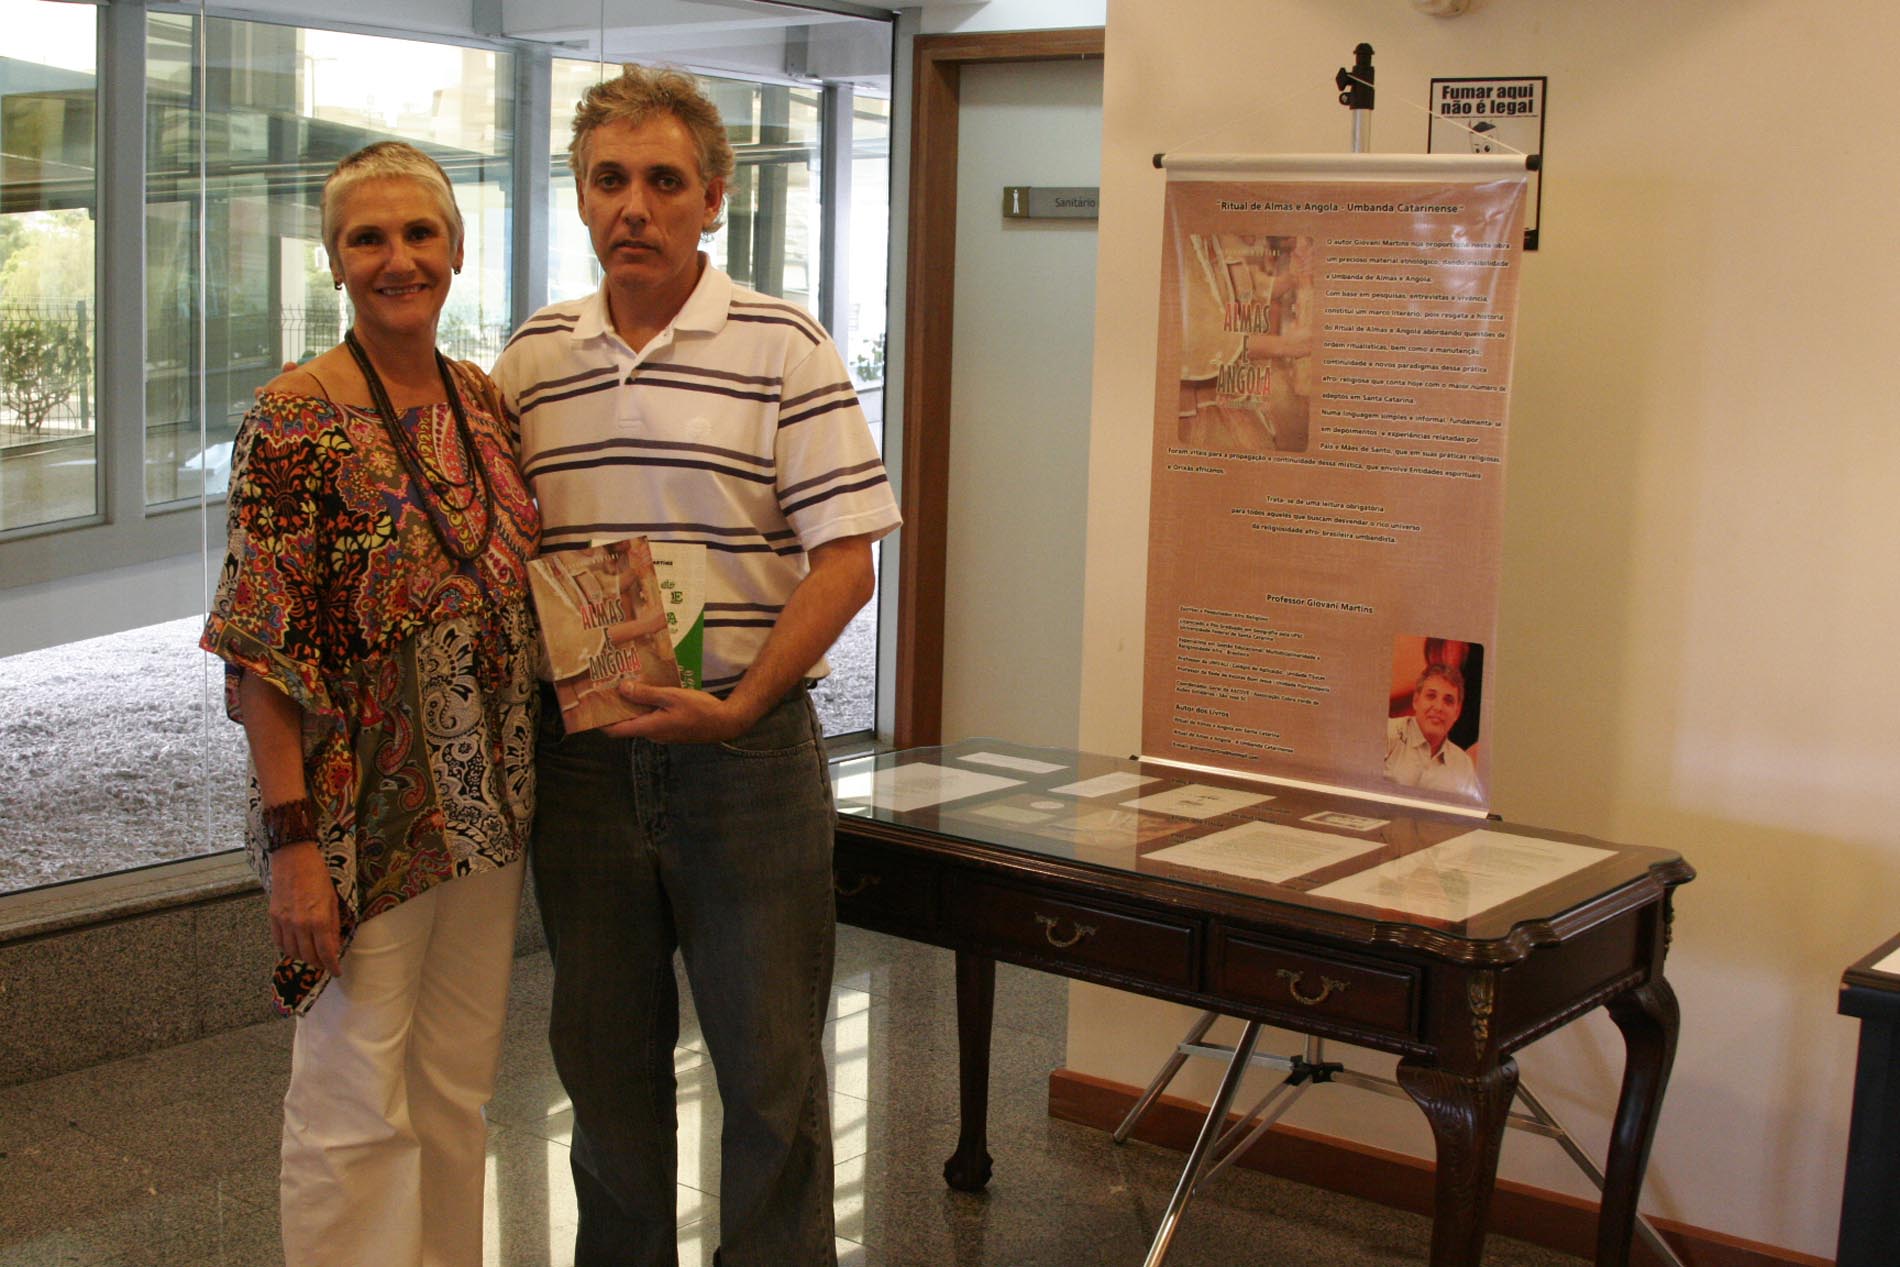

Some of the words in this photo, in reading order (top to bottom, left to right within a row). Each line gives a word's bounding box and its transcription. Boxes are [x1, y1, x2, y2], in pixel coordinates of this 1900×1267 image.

[1442, 86, 1492, 100] Fumar
[1496, 84, 1534, 100] aqui
[1441, 100, 1472, 114] não
[1476, 100, 1486, 114] é
[1490, 100, 1534, 115] legal
[1056, 196, 1096, 208] Sanitário
[1250, 202, 1261, 210] de
[1264, 202, 1293, 210] Almas
[1304, 202, 1338, 212] Angola
[1347, 202, 1394, 211] Umbanda
[1224, 304, 1270, 334] ALMAS
[1242, 335, 1249, 364] E
[1217, 364, 1271, 394] ANGOLA
[1342, 410, 1378, 419] linguagem
[1332, 427, 1376, 435] depoimentos
[1273, 456, 1315, 464] continuidade
[1409, 467, 1443, 475] Entidades
[1306, 514, 1332, 522] buscam
[1333, 517, 1368, 526] desvendar
[1322, 529, 1352, 538] brasileira
[1266, 594, 1304, 605] Professor
[1306, 598, 1338, 609] Giovani
[1340, 602, 1372, 613] Martins
[581, 598, 625, 630] ALMAS
[590, 647, 641, 680] ANGOLA
[1175, 704, 1194, 712] Autor
[1209, 708, 1229, 717] Livros
